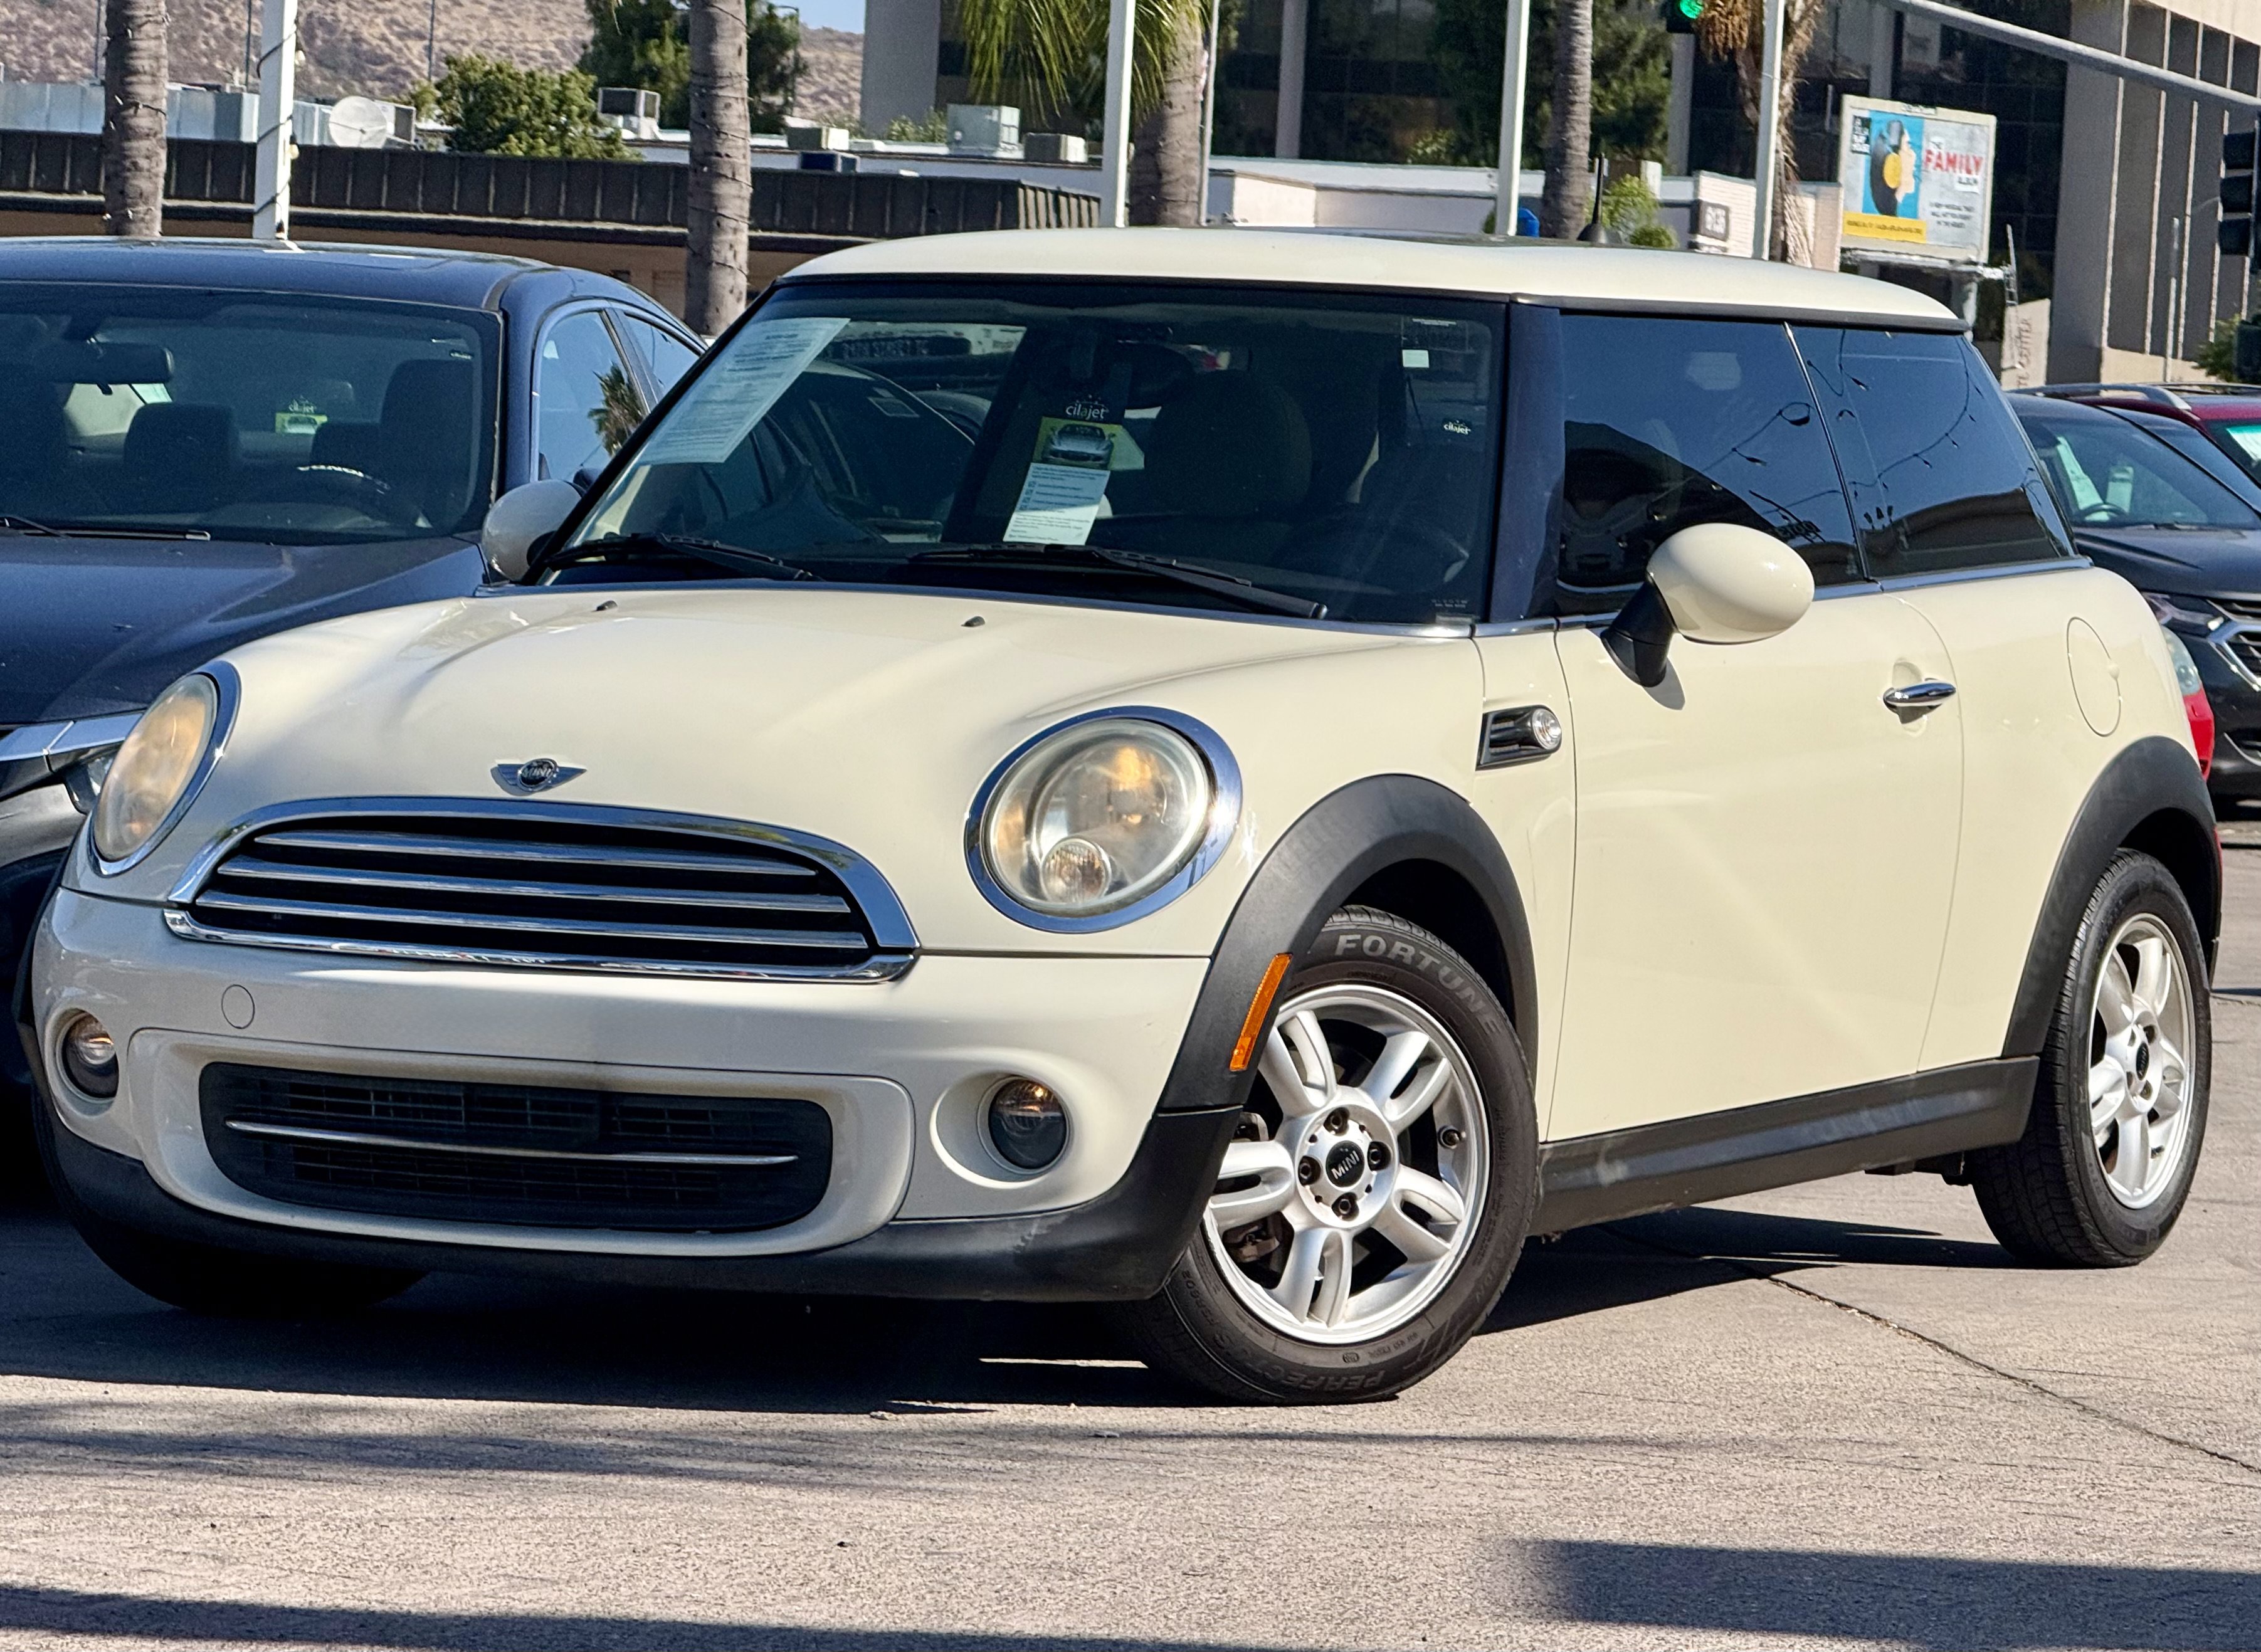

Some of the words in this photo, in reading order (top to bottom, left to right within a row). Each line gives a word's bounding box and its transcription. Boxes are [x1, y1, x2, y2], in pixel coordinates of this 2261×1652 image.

[1923, 149, 1984, 176] FAMILY
[1066, 403, 1107, 421] cilajet
[1443, 421, 1471, 435] cilajet
[1334, 934, 1502, 1036] FORTUNE
[1331, 1150, 1360, 1179] MINI
